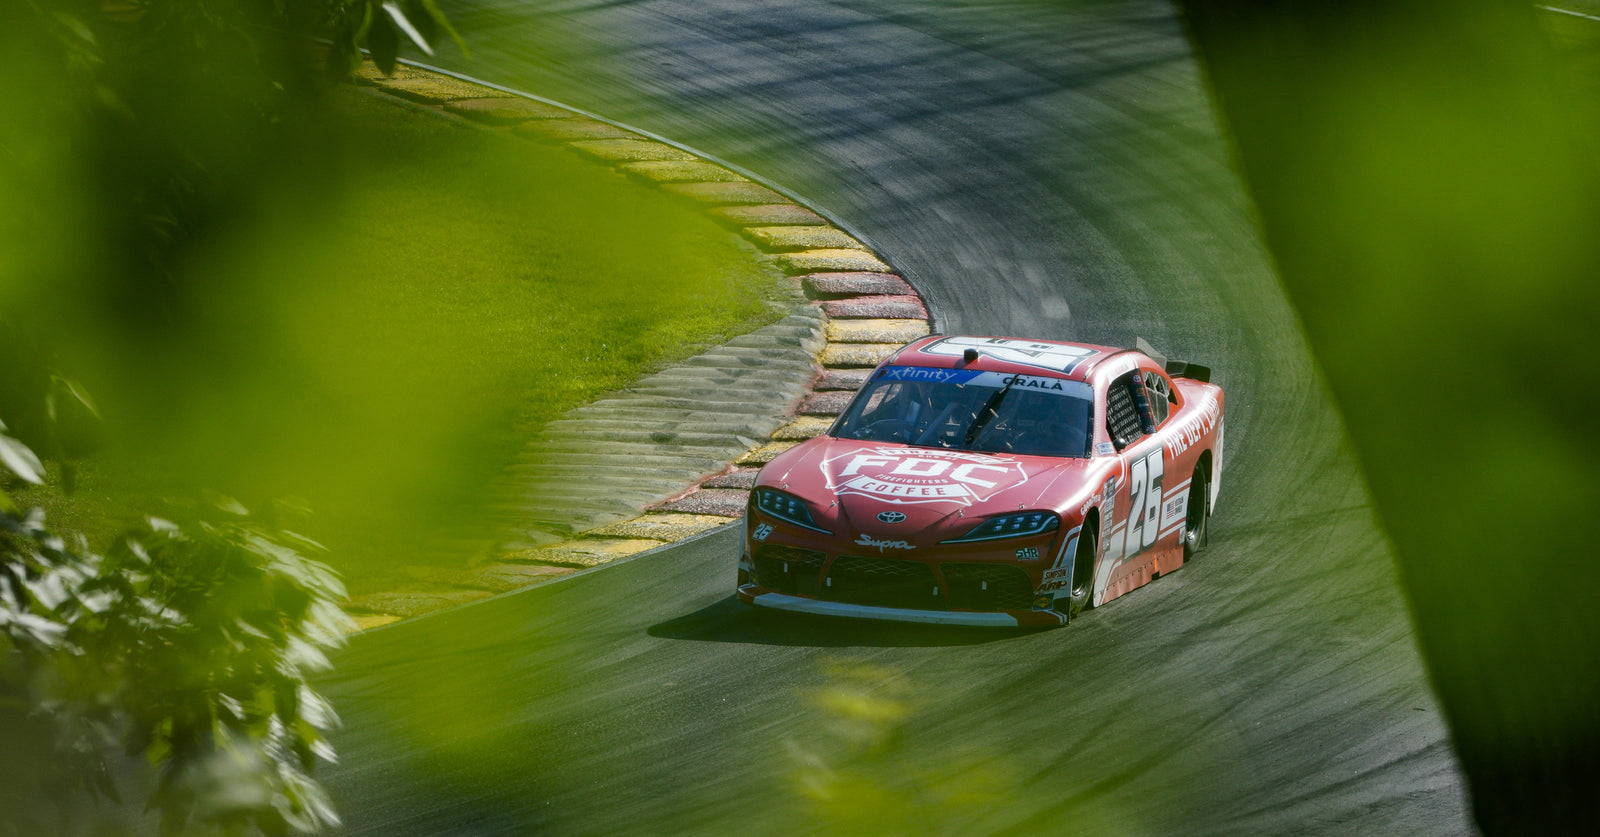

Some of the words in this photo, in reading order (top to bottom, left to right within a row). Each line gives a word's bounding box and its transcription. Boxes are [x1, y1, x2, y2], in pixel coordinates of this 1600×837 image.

[889, 367, 957, 383] xfinity
[1163, 428, 1188, 461] FIRE
[837, 454, 1009, 489] FDC
[876, 473, 949, 484] FIREFIGHTERS
[861, 482, 947, 496] COFFEE
[1124, 447, 1164, 559] 26
[752, 522, 777, 542] 26
[854, 533, 916, 553] Supra
